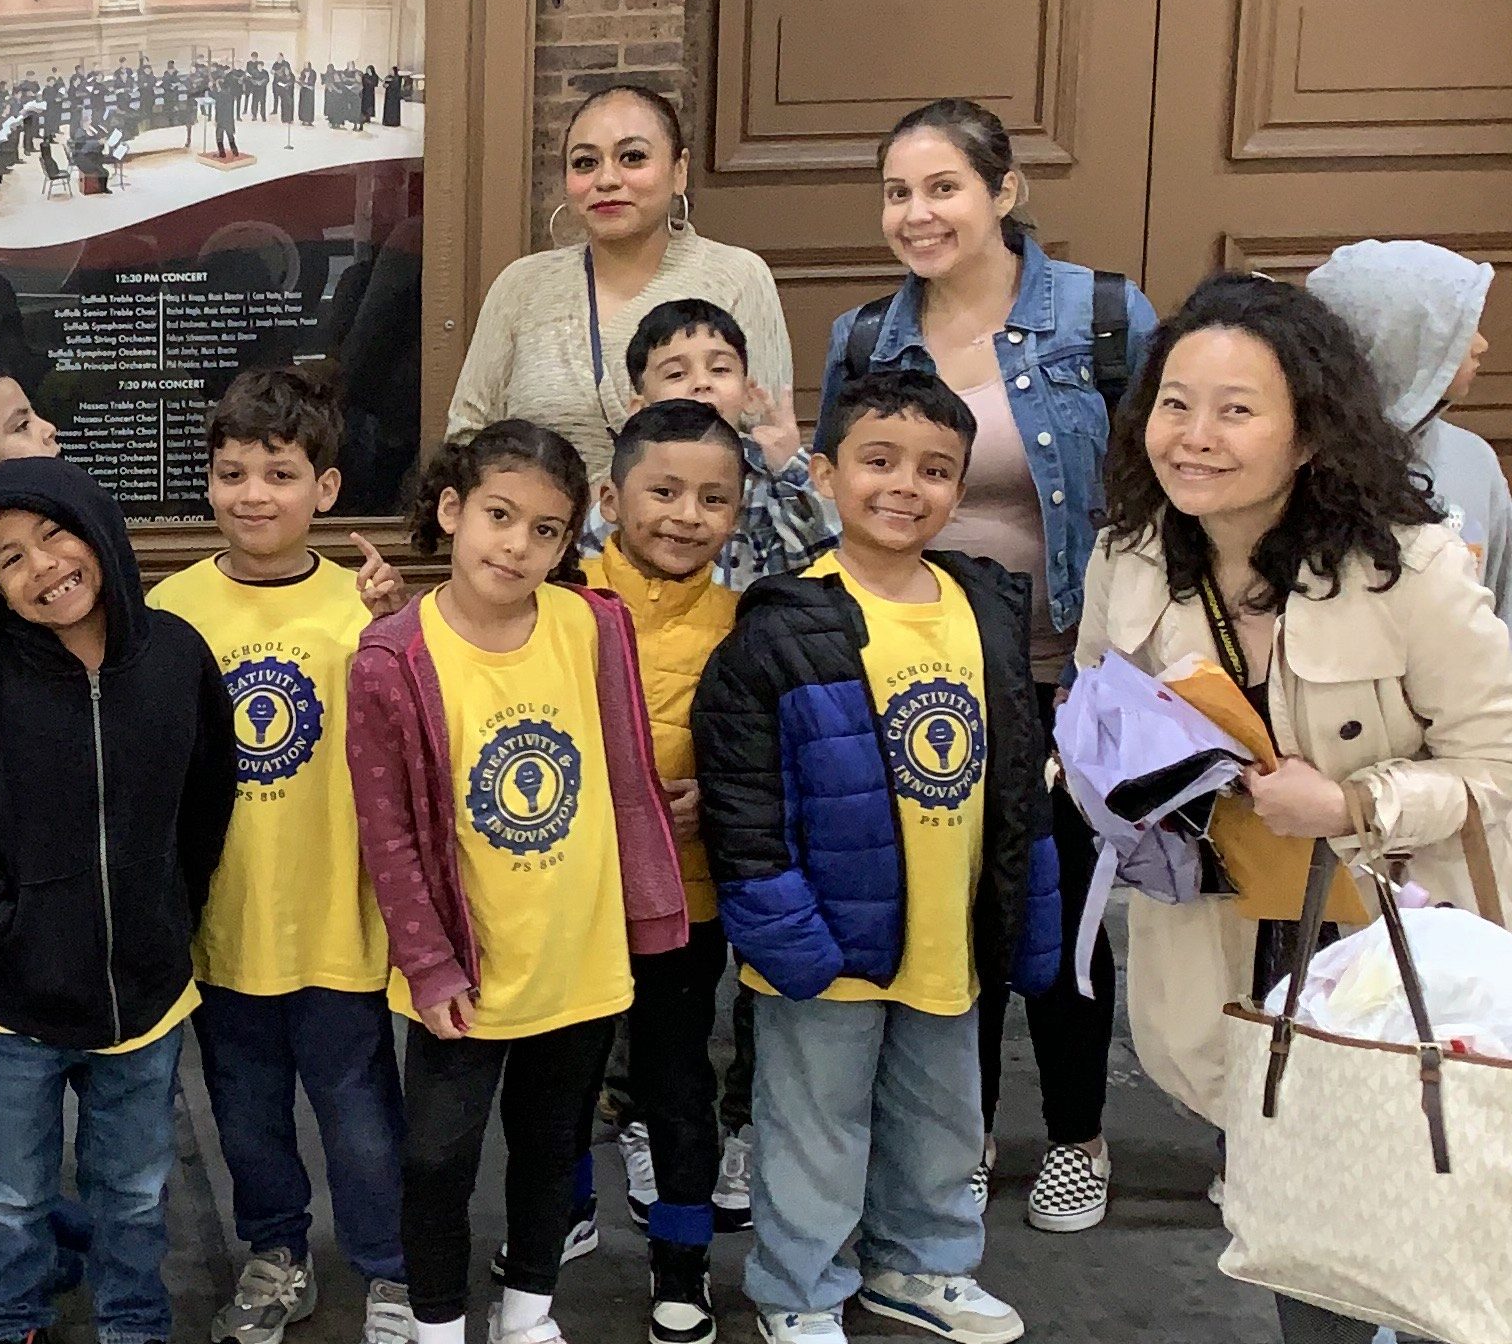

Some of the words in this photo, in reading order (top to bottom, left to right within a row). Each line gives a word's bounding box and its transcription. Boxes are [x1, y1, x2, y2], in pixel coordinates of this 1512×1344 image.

[116, 274, 142, 284] 12:30
[144, 273, 159, 283] PM
[161, 272, 208, 283] CONCERT
[141, 380, 157, 389] PM
[159, 379, 205, 389] CONCERT
[221, 641, 284, 666] SCHOOL
[291, 646, 311, 661] OF
[226, 669, 301, 697] EATIVITY
[886, 662, 953, 688] SCHOOL
[478, 702, 535, 737] SCHOOL
[542, 703, 560, 717] OF
[887, 691, 974, 741] CREATIVITY
[238, 736, 307, 774] OVATION
[479, 733, 561, 792] CREATIVITY
[893, 758, 980, 799] INNOVATION
[235, 788, 253, 802] PS
[485, 794, 574, 843] INNOVATION
[920, 815, 939, 827] PS
[511, 861, 532, 873] PS
